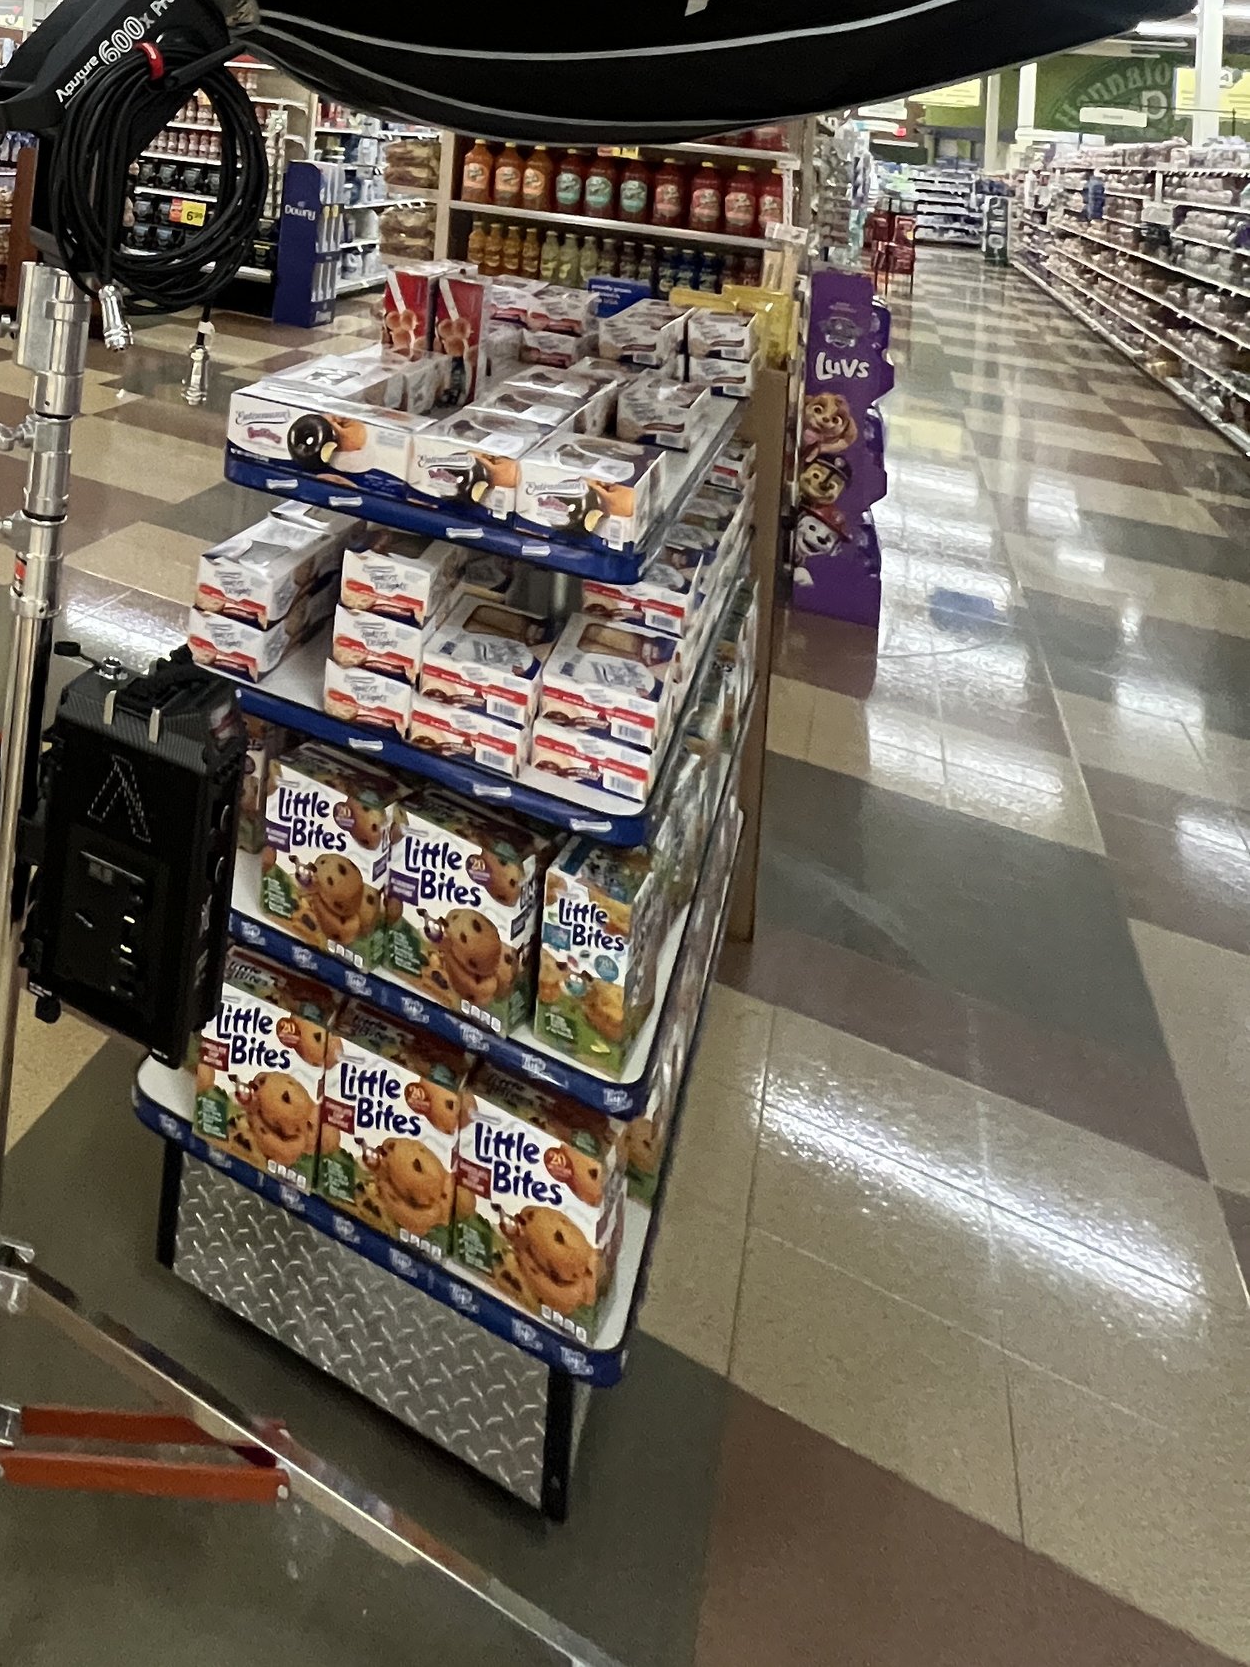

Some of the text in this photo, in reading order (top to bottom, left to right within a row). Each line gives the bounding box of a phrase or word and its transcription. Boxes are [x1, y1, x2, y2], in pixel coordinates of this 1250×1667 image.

[55, 55, 99, 103] Aputure
[284, 204, 316, 221] Downy
[815, 351, 870, 381] Luvs
[278, 787, 330, 822] Little
[291, 818, 347, 852] Bites
[405, 836, 463, 874] Little
[470, 856, 486, 872] 20
[419, 869, 482, 907] Bites
[558, 897, 608, 927] Little
[571, 923, 625, 952] Bites
[216, 1002, 274, 1040] Little
[280, 1021, 297, 1034] 20
[230, 1035, 291, 1070] Bites
[340, 1062, 401, 1102] Little
[356, 1097, 421, 1137] Bites
[474, 1121, 540, 1165] Little
[548, 1151, 567, 1167] 20
[492, 1161, 563, 1206] Bites
